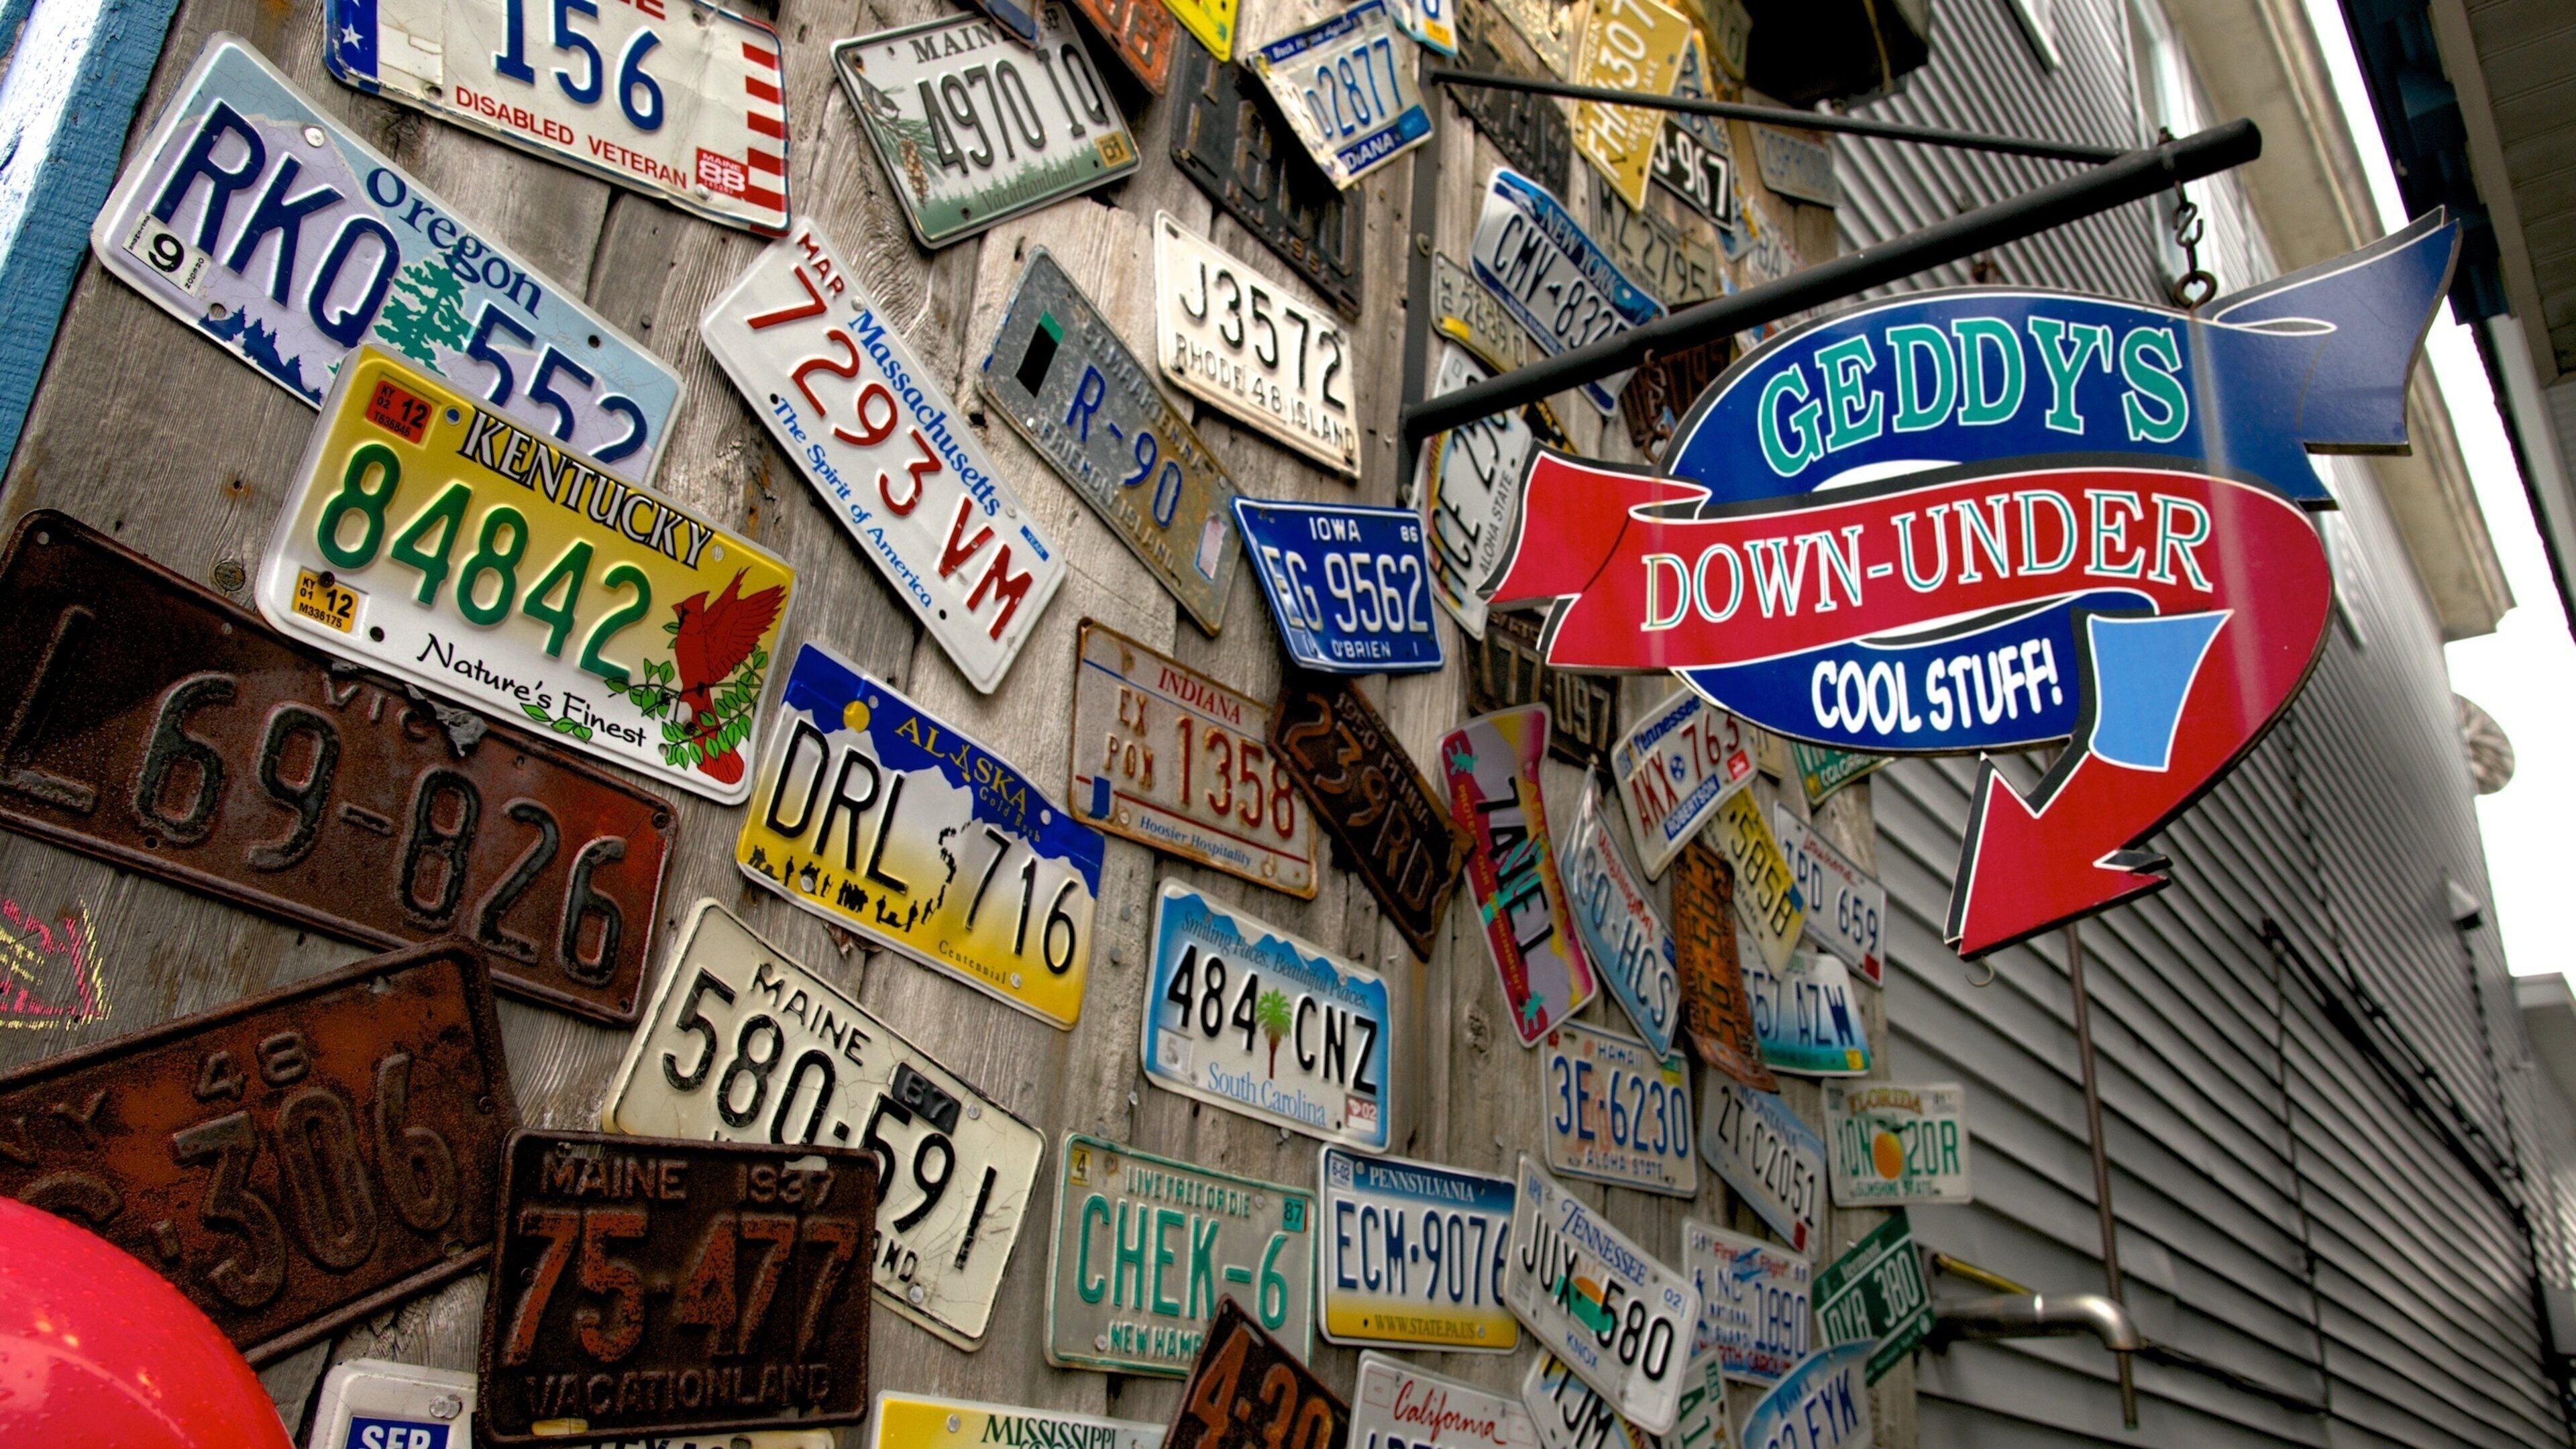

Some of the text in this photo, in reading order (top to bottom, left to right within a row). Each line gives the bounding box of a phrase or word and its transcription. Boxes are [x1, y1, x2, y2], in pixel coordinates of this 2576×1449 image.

[491, 0, 664, 131] 156
[908, 22, 1003, 64] MAIN
[455, 86, 687, 190] DISABLED VETERAN
[914, 59, 1047, 176] 4970
[699, 160, 746, 192] 88
[702, 152, 742, 172] MAINE
[981, 159, 1078, 212] Vacationland
[1344, 132, 1395, 176] DIANA
[148, 233, 184, 272] 9
[367, 168, 543, 319] Oregon
[797, 232, 845, 300] MAR
[1493, 213, 1558, 303] CMV
[1542, 204, 1621, 303] NEW YORK
[152, 99, 649, 463] RKQ 552
[1179, 262, 1346, 411] J3572
[376, 396, 390, 410] 02
[380, 384, 395, 398] KY
[401, 398, 428, 429] 12
[847, 309, 1002, 517] Massachusetts
[1175, 333, 1356, 459] RHODE 48 ISLAND
[1757, 315, 2190, 478] GEDDY'S
[745, 264, 1034, 642] 7293 VM
[1066, 364, 1183, 529] R-90
[458, 409, 716, 570] KENTUCKY
[773, 399, 934, 608] The Spirit of America
[1476, 468, 1514, 576] ALOHA STATE
[317, 443, 652, 682] 84842
[1309, 517, 1419, 543] IOWA 86
[1641, 488, 2213, 631] DOWN-UNDER
[299, 602, 343, 629] M336175
[300, 588, 313, 600] 01
[302, 576, 316, 590] KY
[325, 589, 354, 619] 12
[1324, 552, 1429, 633] 9562
[1332, 640, 1391, 659] O'BRIEN
[417, 633, 647, 748] Nature's Finest
[1118, 686, 1147, 737] EX
[1158, 666, 1242, 725] INDIANA
[1811, 637, 2063, 736] COOL STUFF!
[1178, 715, 1295, 839] 1358
[1630, 747, 1680, 838] AKX
[765, 718, 1080, 975] DRL 716
[977, 785, 1042, 843] Gold Rush
[1140, 815, 1252, 866] Hoosier Hospitality
[1838, 887, 1878, 953] 659
[938, 939, 1007, 986] Centennial
[1181, 911, 1369, 1010] Smiling Faces. Beautiful Places.
[753, 962, 872, 1067] MAINE
[1167, 943, 1377, 1096] 484 CNZ
[194, 1030, 310, 1104] 48
[1597, 1042, 1644, 1068] HAWAII
[1208, 1061, 1327, 1128] South Carolina
[1361, 1103, 1377, 1121] 02
[1847, 1087, 1924, 1118] FLORIDA
[540, 1155, 839, 1207] MAINE 1937
[1077, 1154, 1087, 1179] 4
[1126, 1165, 1250, 1218] LIVE FREE OR DIE
[1369, 1166, 1475, 1202] PENNSYLVANIA
[1283, 1201, 1303, 1222] 87
[1561, 1198, 1648, 1287] TENNESSEE
[505, 1208, 861, 1368] 75-477
[1077, 1193, 1289, 1330] CHEK-6
[1873, 1250, 1921, 1328] 380
[1375, 1314, 1475, 1339] WWW.STATE.PA.US
[1520, 1212, 1674, 1381] JUX 580
[1664, 1287, 1682, 1307] 02
[1108, 1320, 1148, 1354] NEW
[1566, 1332, 1599, 1371] KNOX
[525, 1362, 833, 1421] VACATIONLAND
[1393, 1379, 1508, 1445] California
[981, 1414, 1117, 1449] MISSISSIPPI
